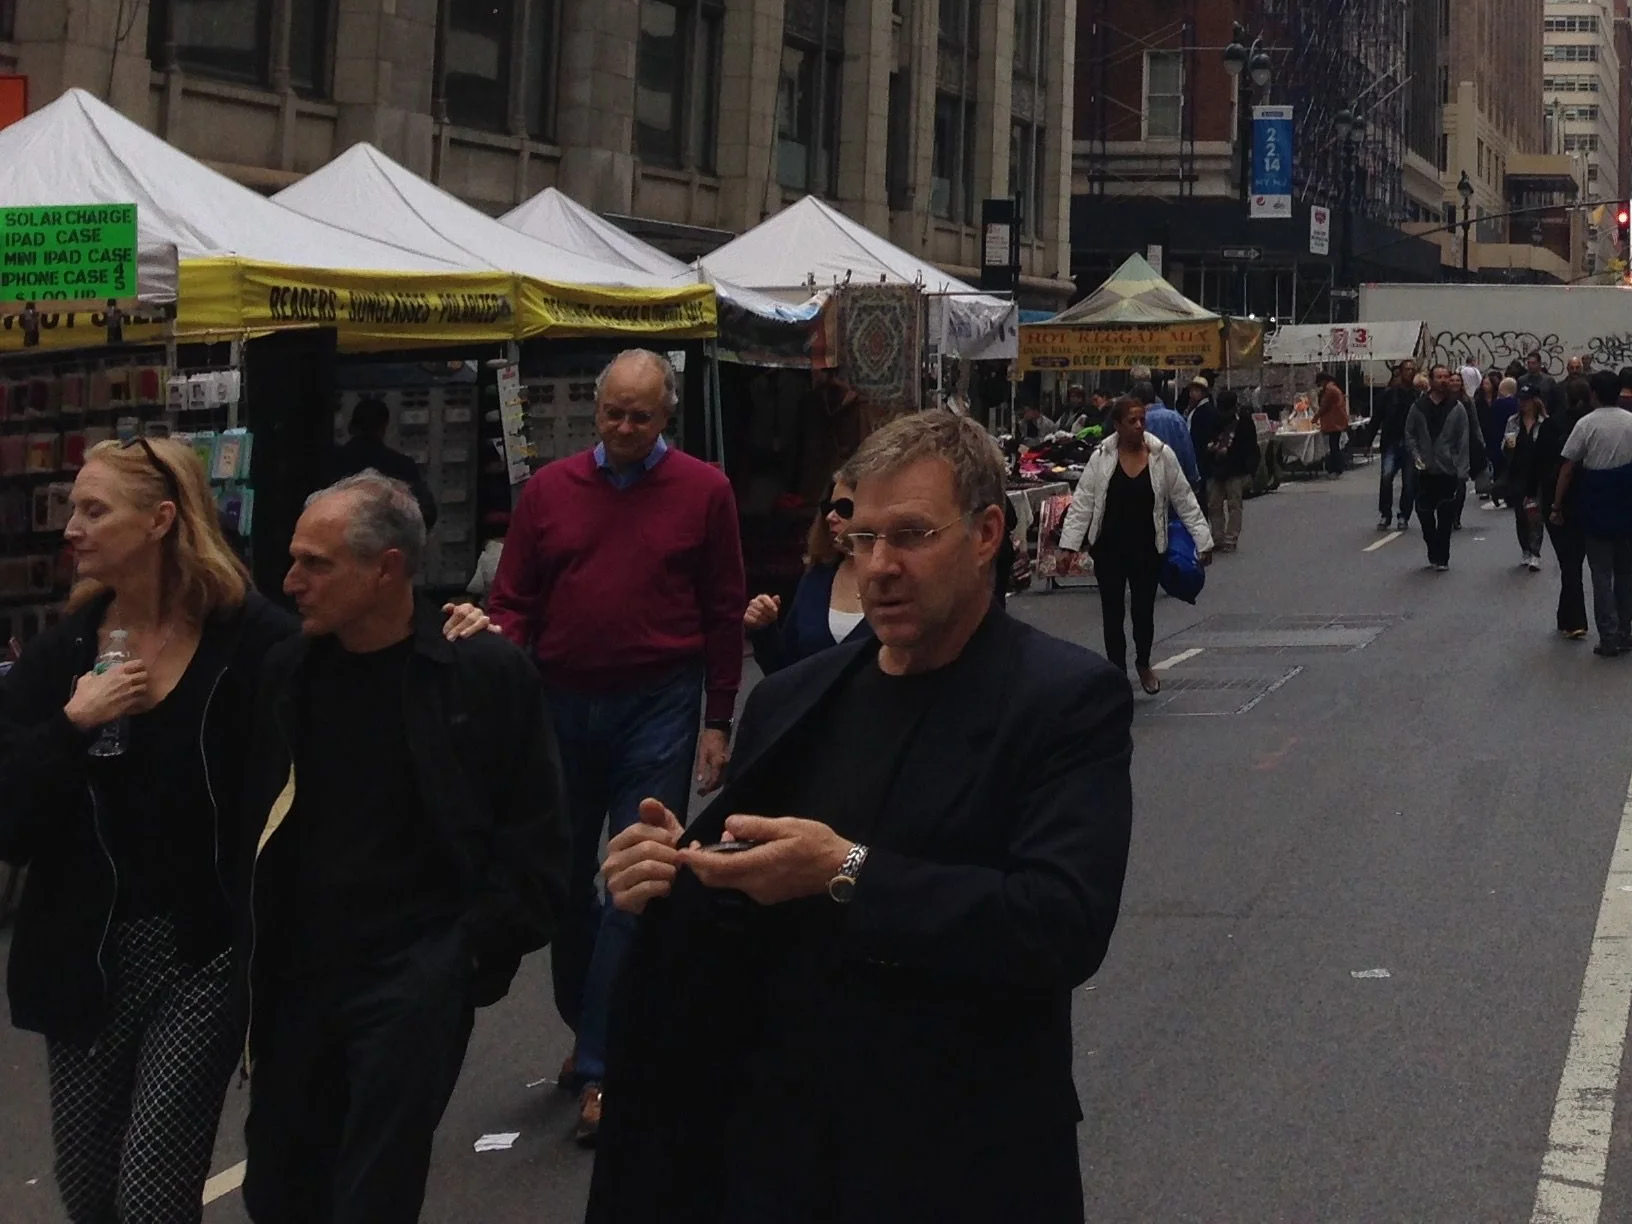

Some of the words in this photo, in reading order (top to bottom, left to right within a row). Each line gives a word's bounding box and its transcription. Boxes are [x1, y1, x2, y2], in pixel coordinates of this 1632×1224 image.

[1264, 158, 1281, 172] 14
[5, 212, 62, 227] SOLAR
[65, 208, 132, 225] CHARGE
[5, 232, 46, 248] IPAD
[56, 228, 103, 245] CASE
[4, 251, 37, 266] MINI
[43, 249, 82, 265] IPAD
[88, 248, 132, 263] CASE
[1, 270, 60, 287] IPHONE
[63, 268, 109, 285] CASE
[269, 285, 337, 322] READERS
[1027, 331, 1066, 344] HOT
